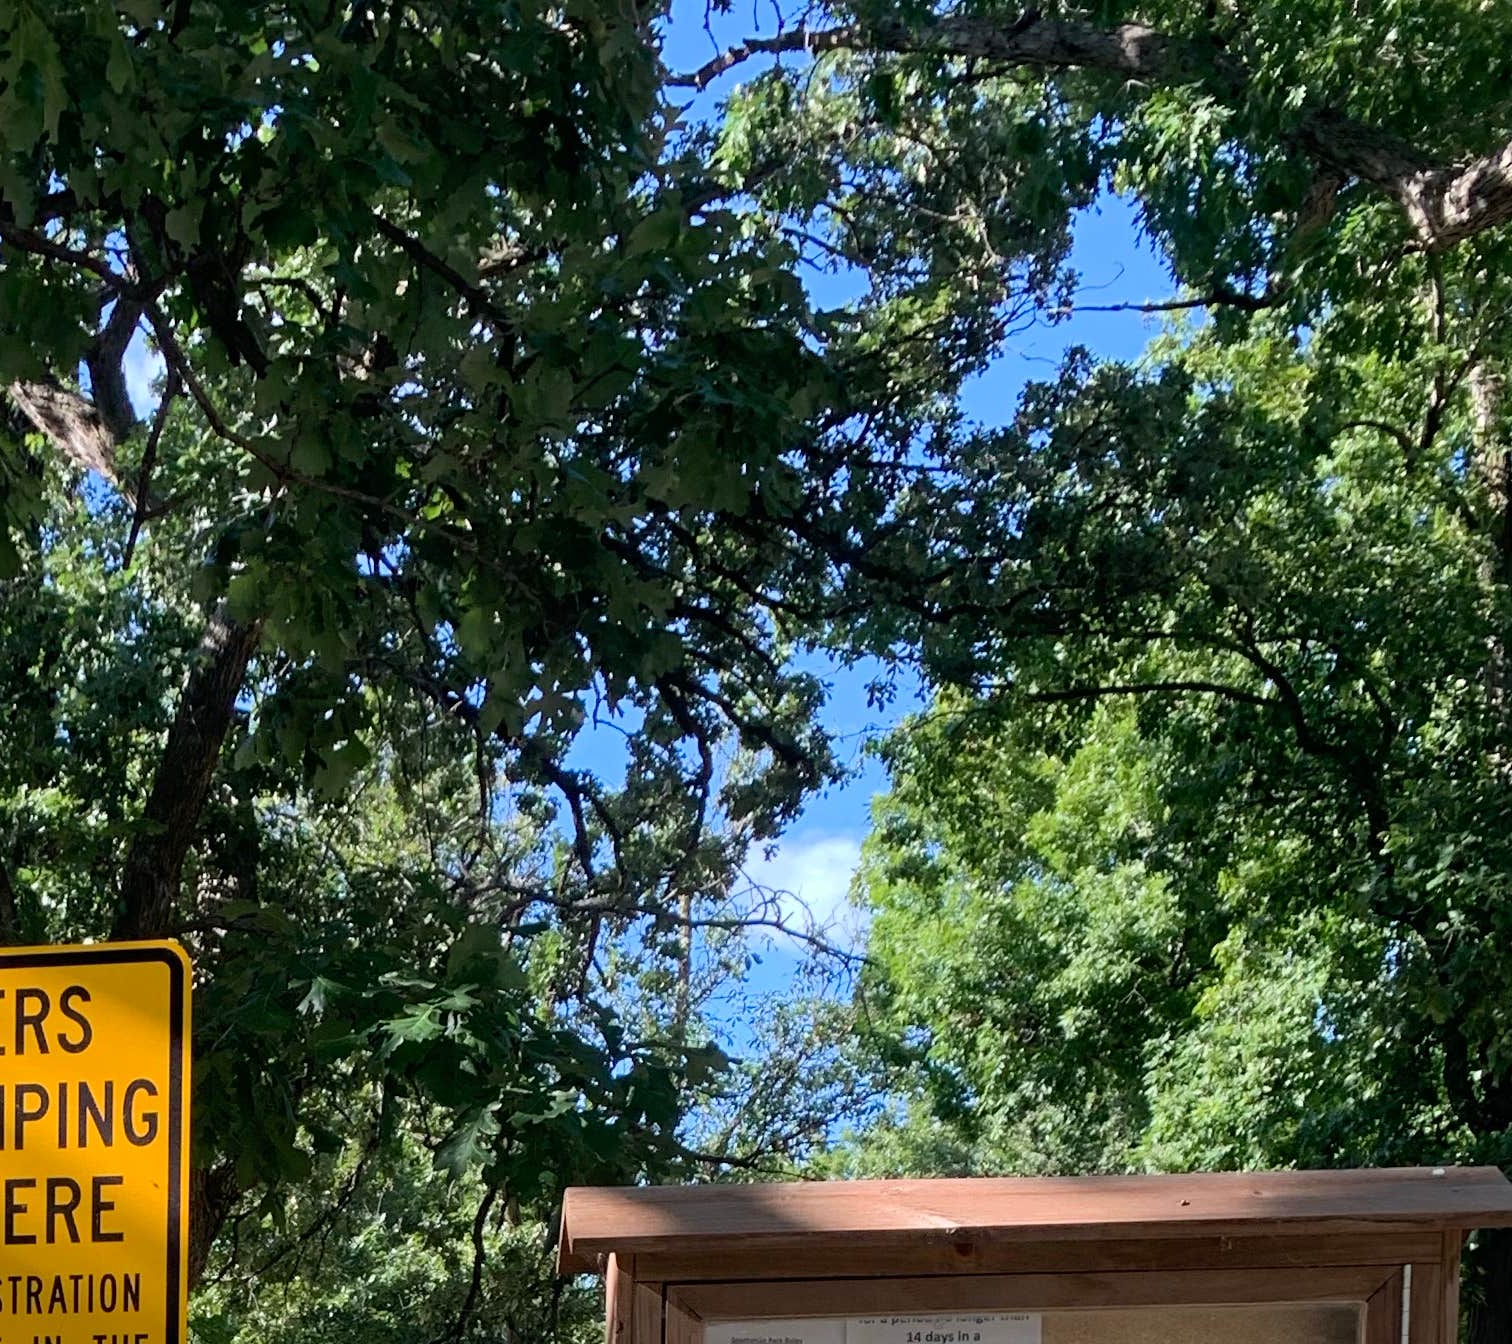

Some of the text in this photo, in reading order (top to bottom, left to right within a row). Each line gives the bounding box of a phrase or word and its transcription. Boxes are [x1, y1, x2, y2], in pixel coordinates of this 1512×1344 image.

[906, 1330, 980, 1344] 14 days in a
